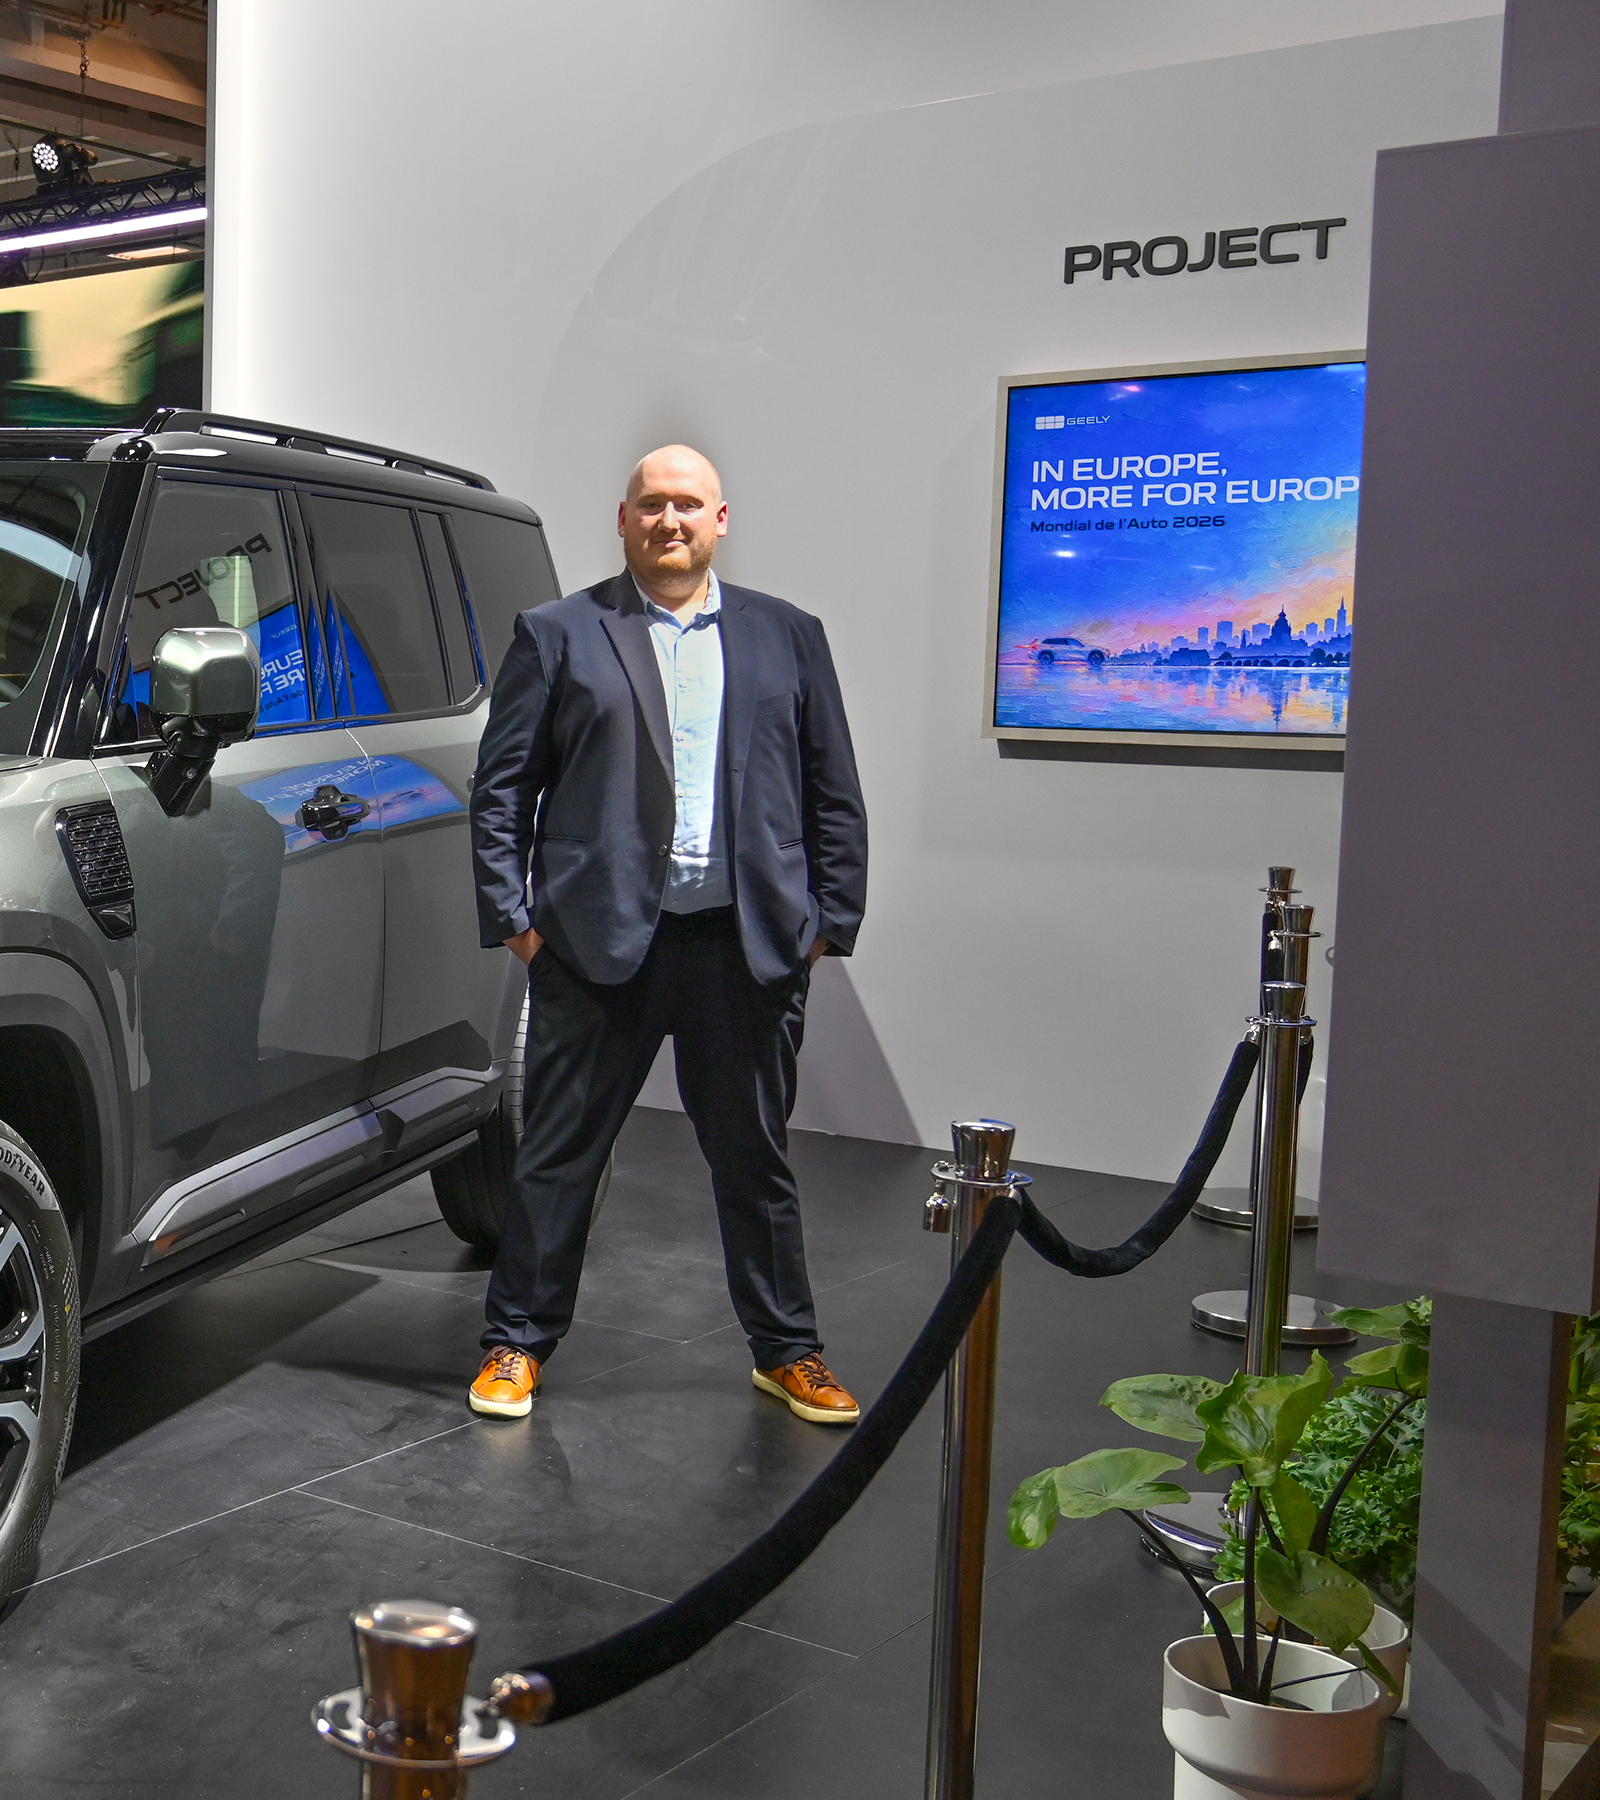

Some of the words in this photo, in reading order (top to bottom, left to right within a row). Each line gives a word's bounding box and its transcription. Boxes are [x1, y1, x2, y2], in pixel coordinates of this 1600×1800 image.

[1063, 217, 1347, 285] PROJECT
[1066, 415, 1111, 426] GEELY
[1032, 459, 1064, 483] IN
[1072, 451, 1228, 481] EUROPE,
[1030, 485, 1134, 511] MORE
[1142, 481, 1217, 507] FOR
[1226, 475, 1360, 504] EUROP
[1030, 519, 1091, 533] Mondial
[1095, 519, 1114, 531] de
[1118, 517, 1168, 529] l'Auto
[1173, 515, 1226, 528] 2026
